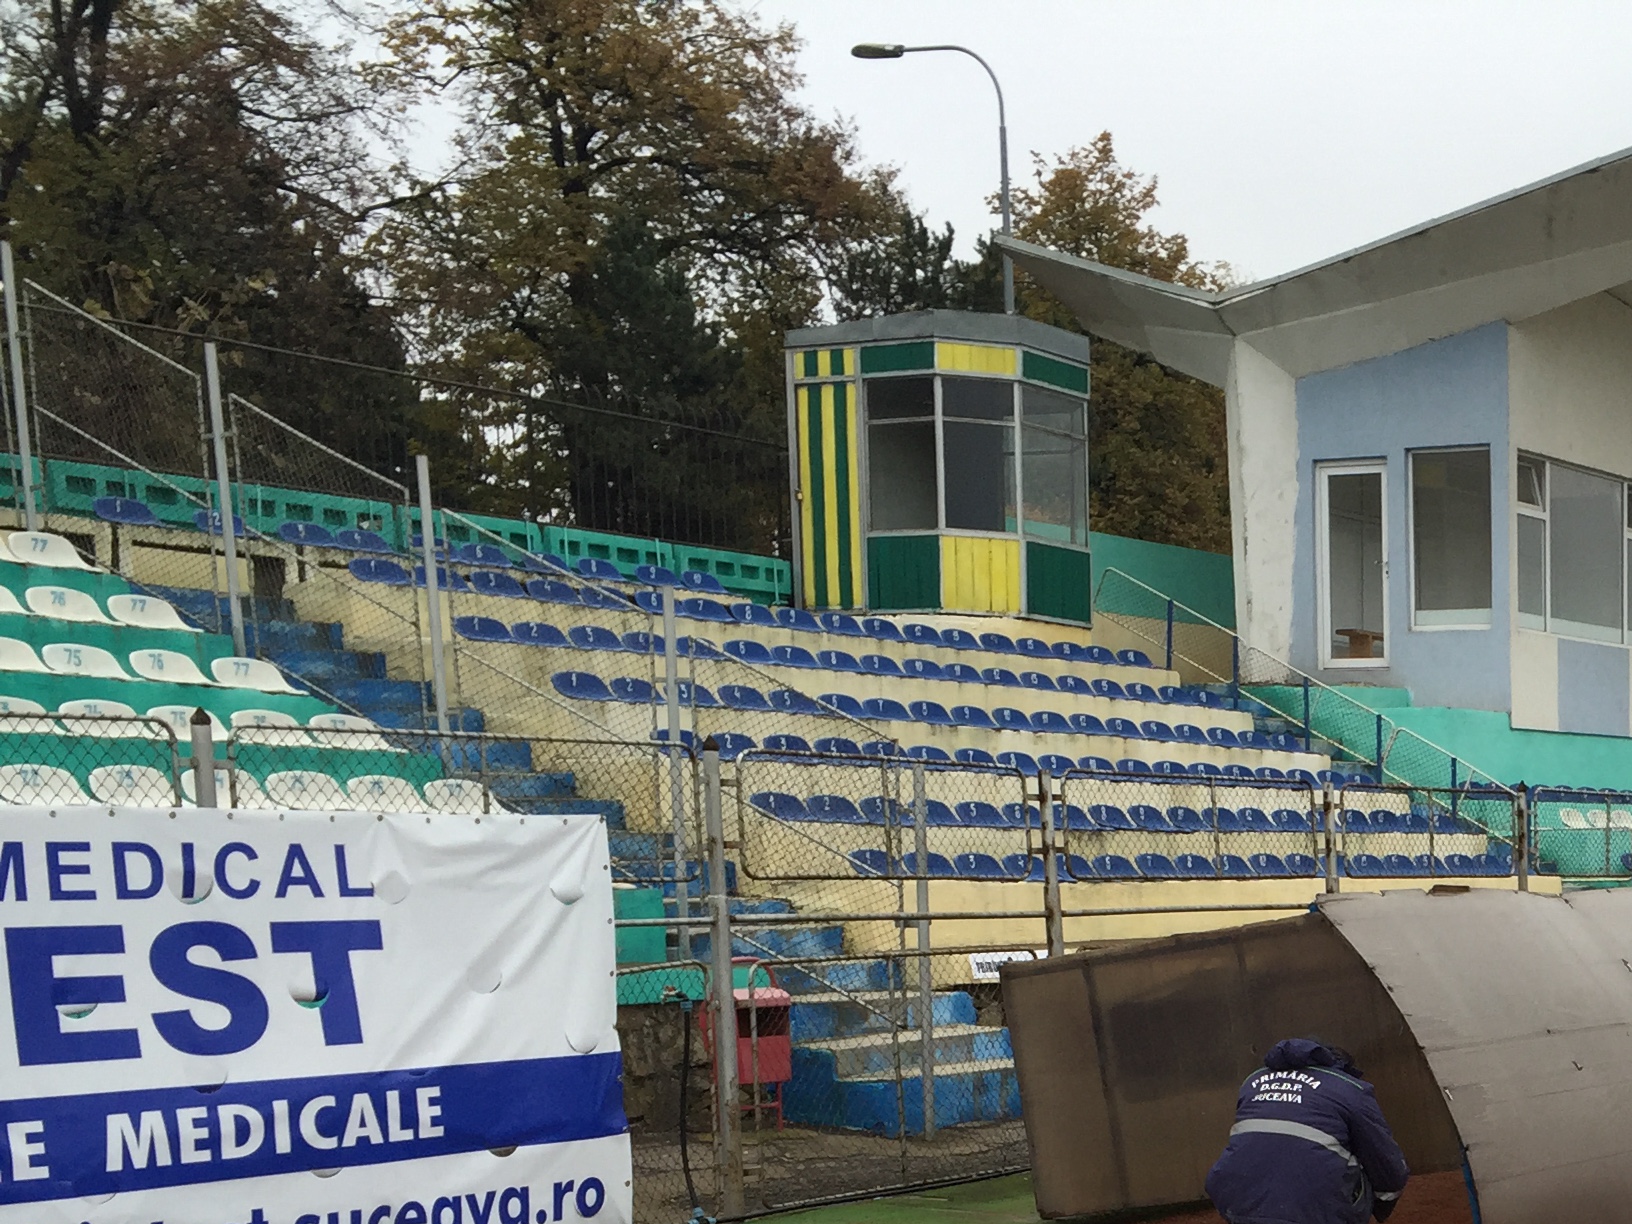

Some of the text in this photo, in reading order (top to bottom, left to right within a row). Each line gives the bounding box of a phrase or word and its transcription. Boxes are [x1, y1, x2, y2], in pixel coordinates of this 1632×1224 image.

[31, 538, 48, 552] 77
[50, 591, 65, 606] 76
[130, 599, 146, 612] 77
[651, 594, 657, 606] 6
[745, 606, 752, 619] 8
[789, 610, 795, 622] 9
[473, 618, 479, 630] 1
[530, 622, 538, 637] 2
[586, 628, 593, 642] 3
[64, 649, 81, 667] 75
[785, 648, 791, 658] 7
[831, 652, 837, 664] 8
[148, 653, 164, 670] 76
[874, 656, 880, 668] 9
[233, 662, 249, 676] 77
[572, 673, 577, 687] 1
[626, 679, 633, 691] 2
[681, 685, 688, 698] 3
[784, 692, 791, 705] 5
[170, 711, 186, 727] 75
[964, 707, 969, 718] 9
[724, 734, 732, 748] 2
[780, 736, 786, 750] 3
[968, 750, 973, 762] 7
[1051, 755, 1057, 769] 9
[215, 772, 224, 788] 4
[970, 803, 976, 817] 5
[969, 855, 976, 868] 3
[0, 1086, 445, 1182] E MEDICALE
